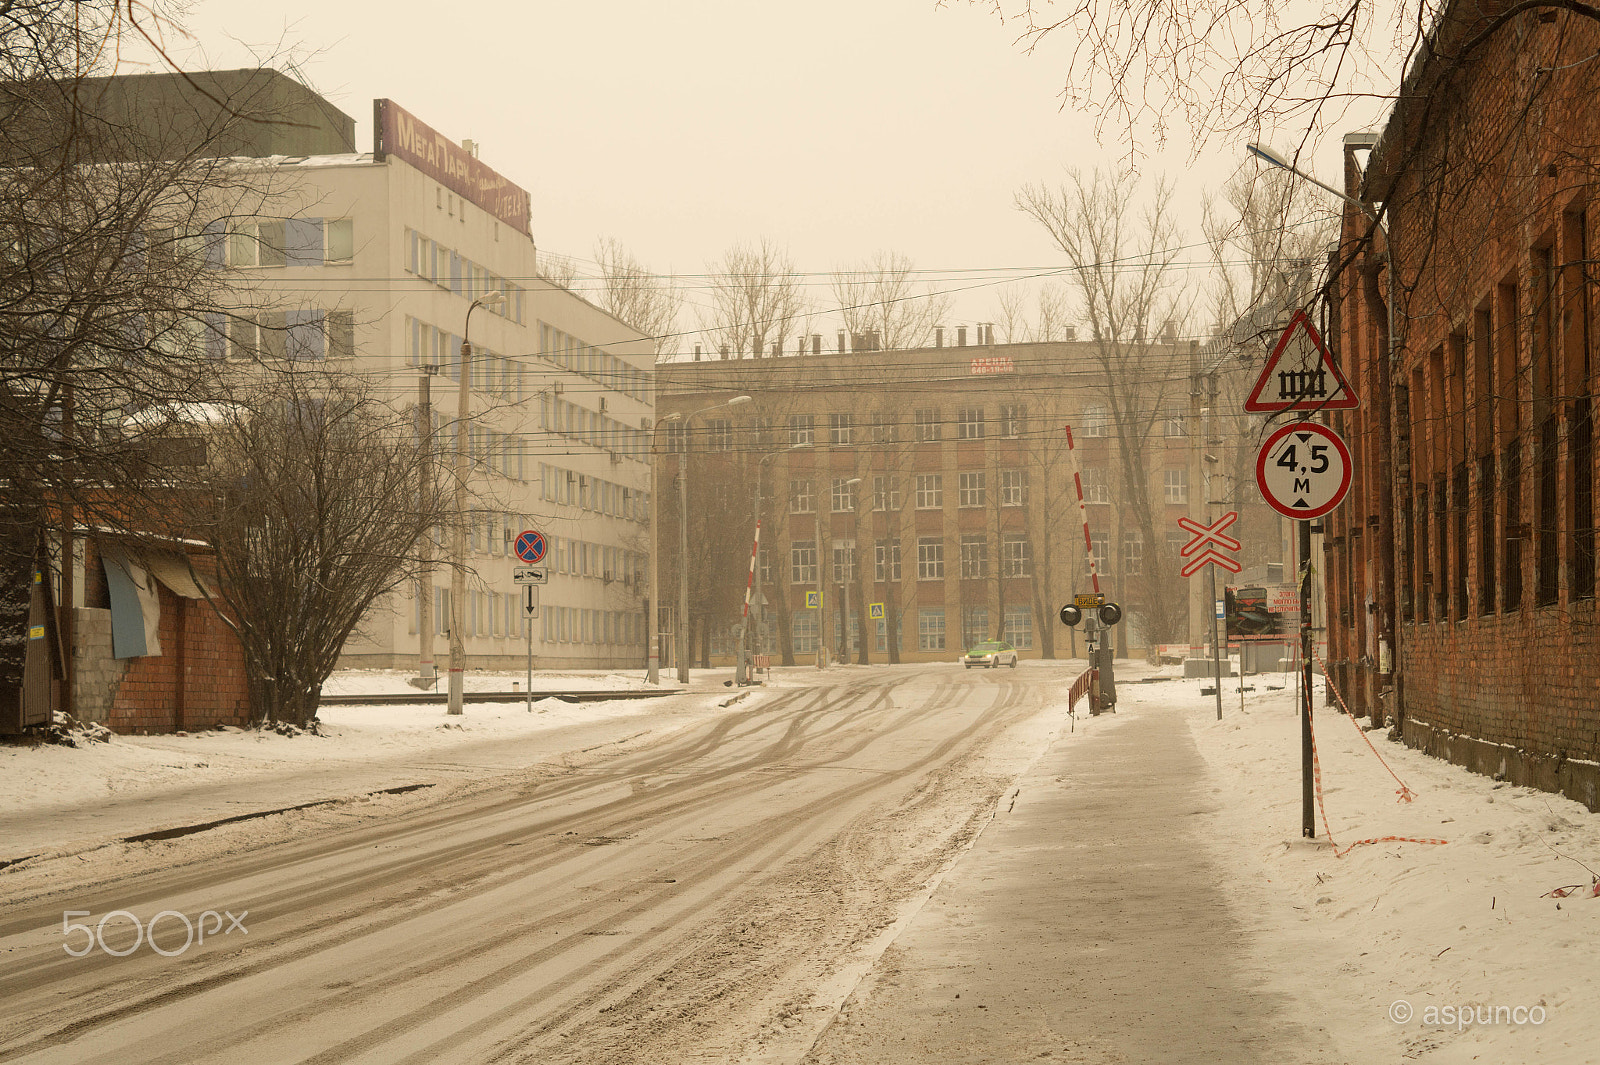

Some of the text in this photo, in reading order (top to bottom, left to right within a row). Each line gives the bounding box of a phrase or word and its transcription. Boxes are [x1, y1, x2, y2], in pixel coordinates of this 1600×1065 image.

[971, 357, 1013, 366] АРЕНДА
[1277, 445, 1329, 475] 4,5
[1293, 478, 1310, 493] м
